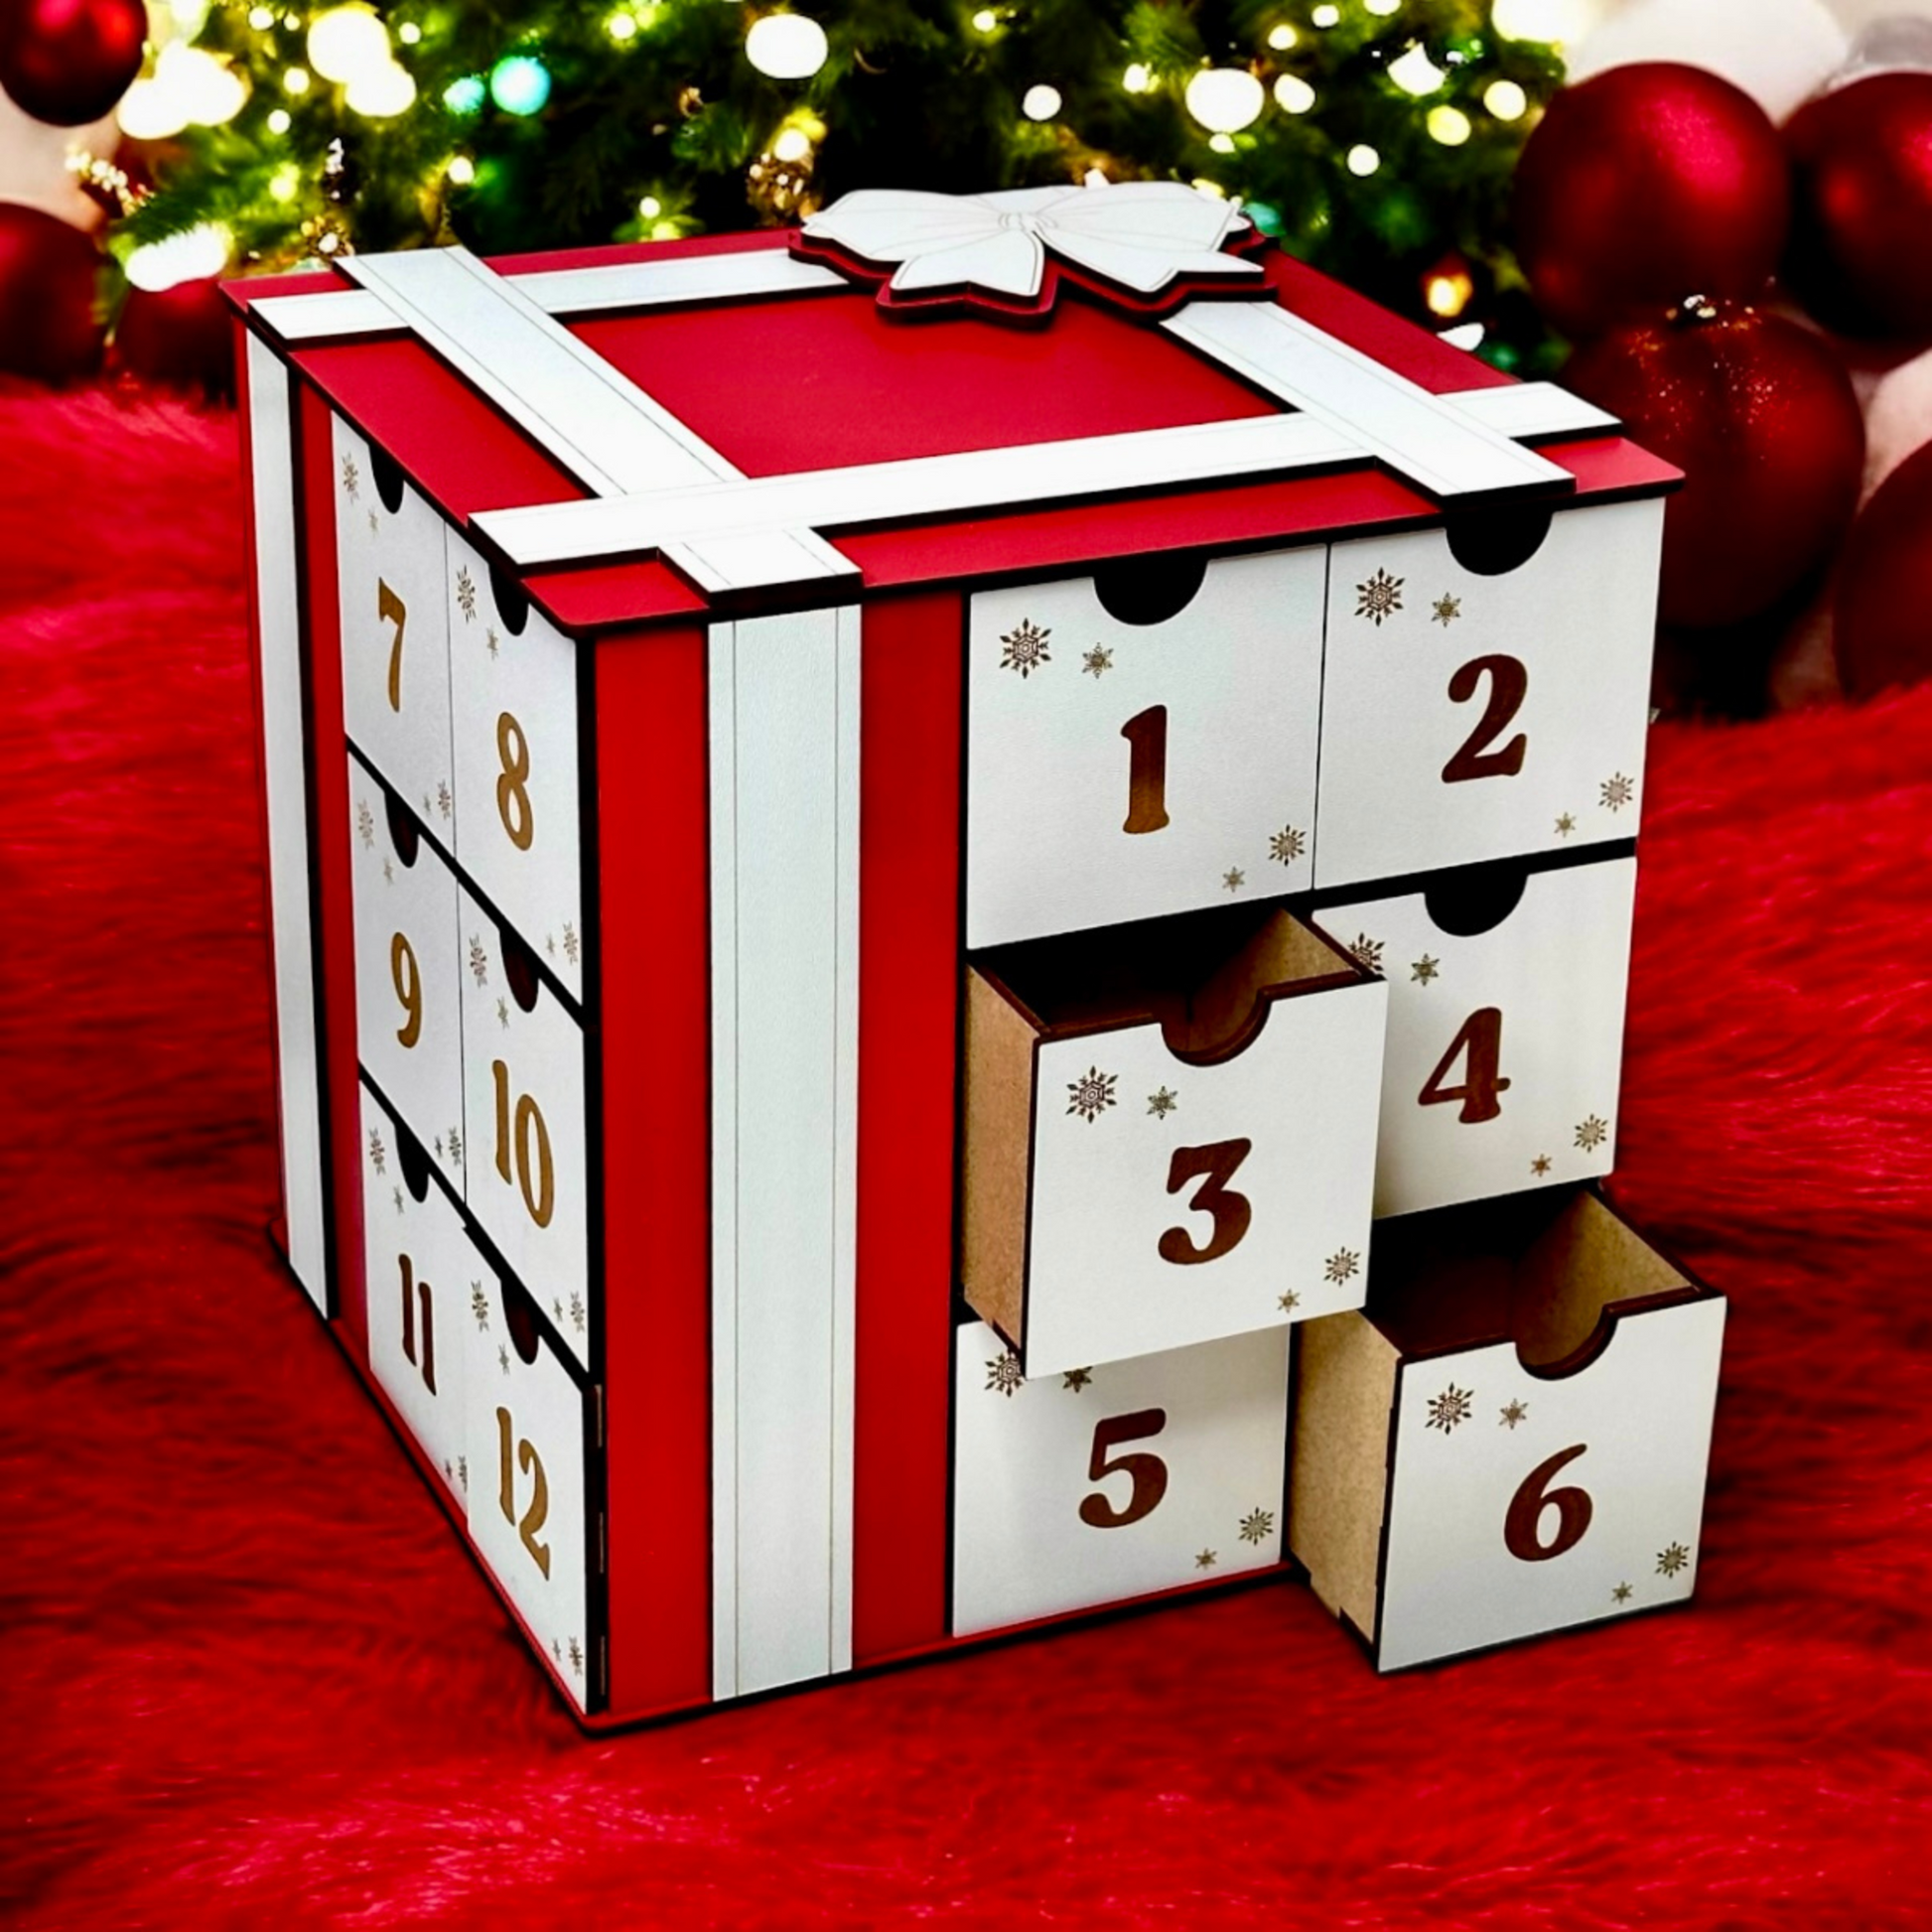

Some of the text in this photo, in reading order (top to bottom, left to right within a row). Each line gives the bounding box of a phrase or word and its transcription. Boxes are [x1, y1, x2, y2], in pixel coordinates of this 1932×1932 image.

[378, 577, 407, 713] 7
[496, 711, 533, 851] 8
[1120, 704, 1171, 835] 1
[1441, 653, 1528, 784] 2
[390, 931, 422, 1049] 9
[1417, 1007, 1511, 1125] 4
[491, 1059, 555, 1229] 10
[1158, 1137, 1252, 1266] 3
[398, 1253, 438, 1397] 11
[495, 1406, 551, 1581] 12
[1078, 1407, 1169, 1529] 5
[1503, 1443, 1593, 1563] 6
